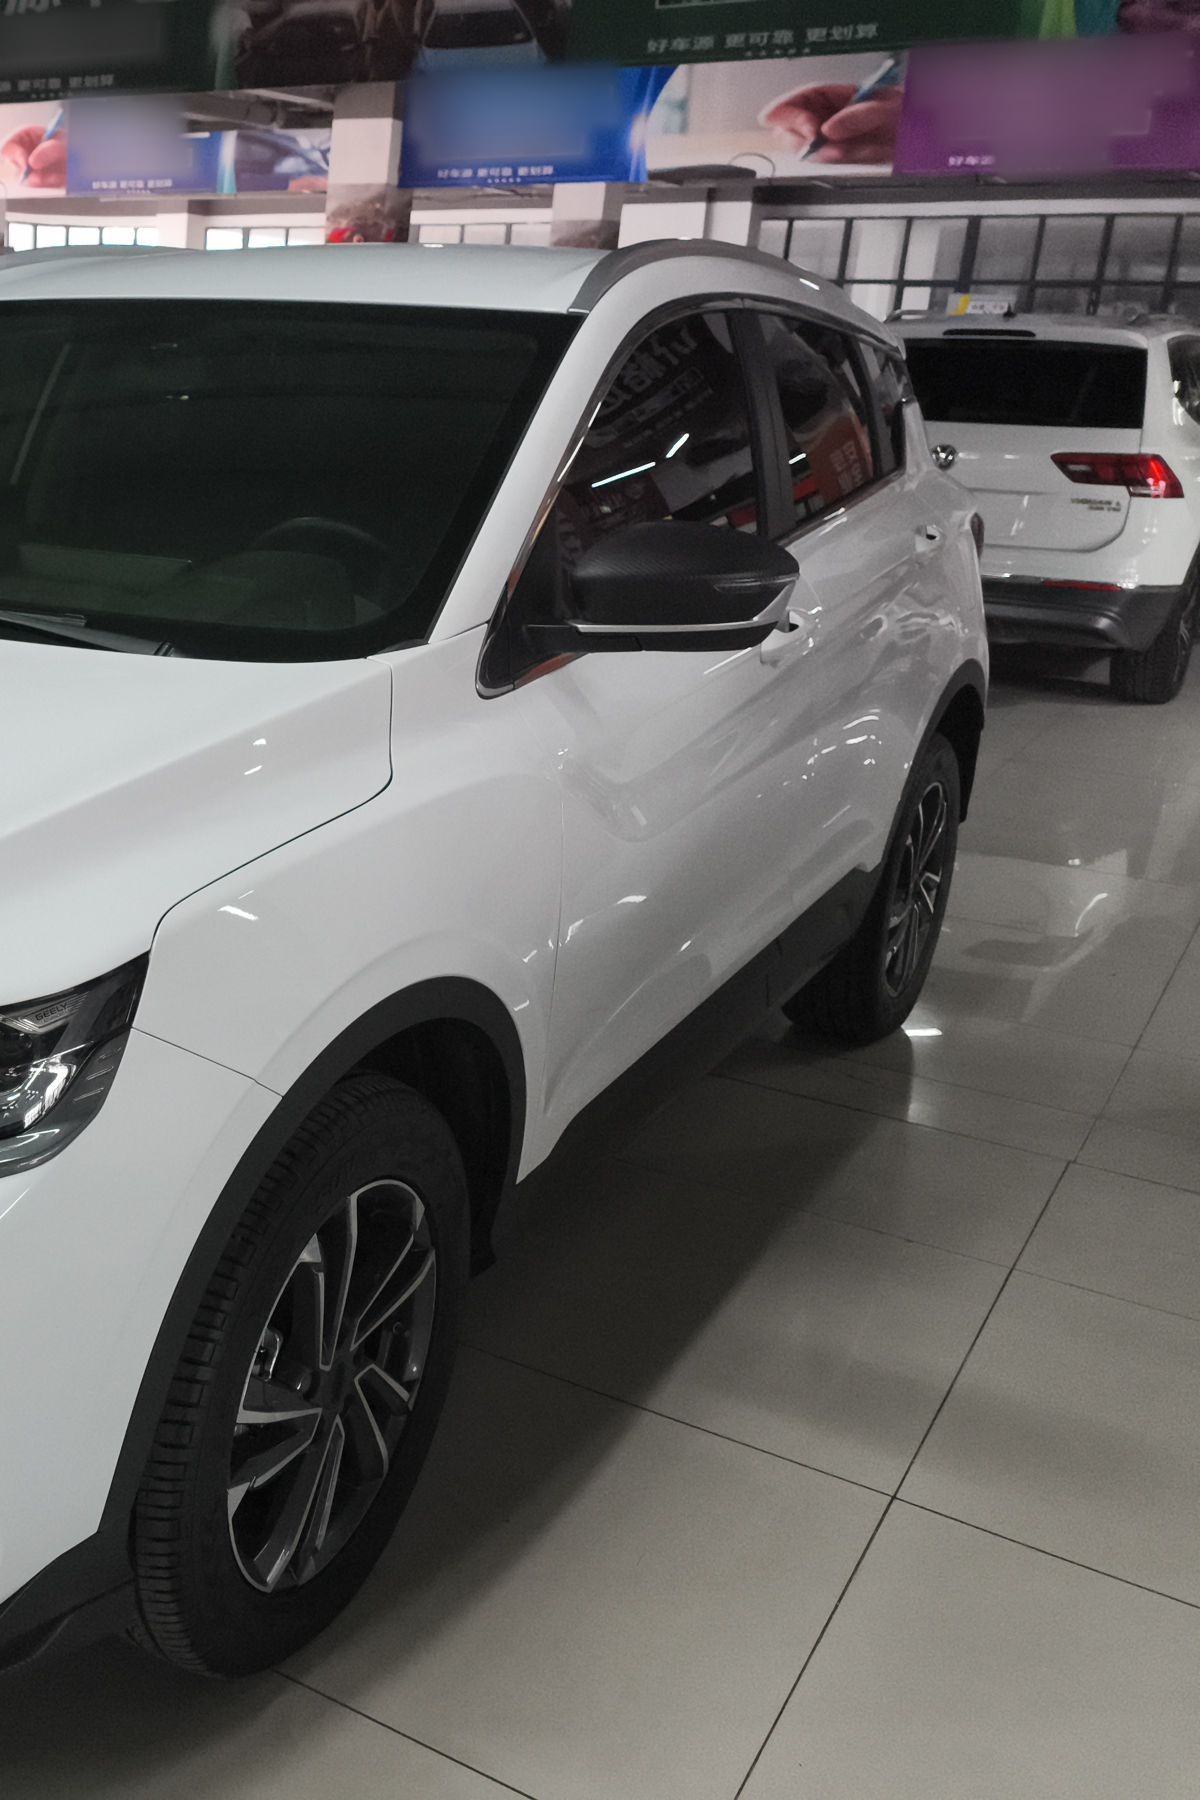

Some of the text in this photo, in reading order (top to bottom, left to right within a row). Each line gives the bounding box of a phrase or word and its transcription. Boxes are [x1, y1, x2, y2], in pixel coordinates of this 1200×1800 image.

[648, 23, 879, 53] 好车源 更可靠 更划算
[35, 1003, 67, 1020] GEELY
